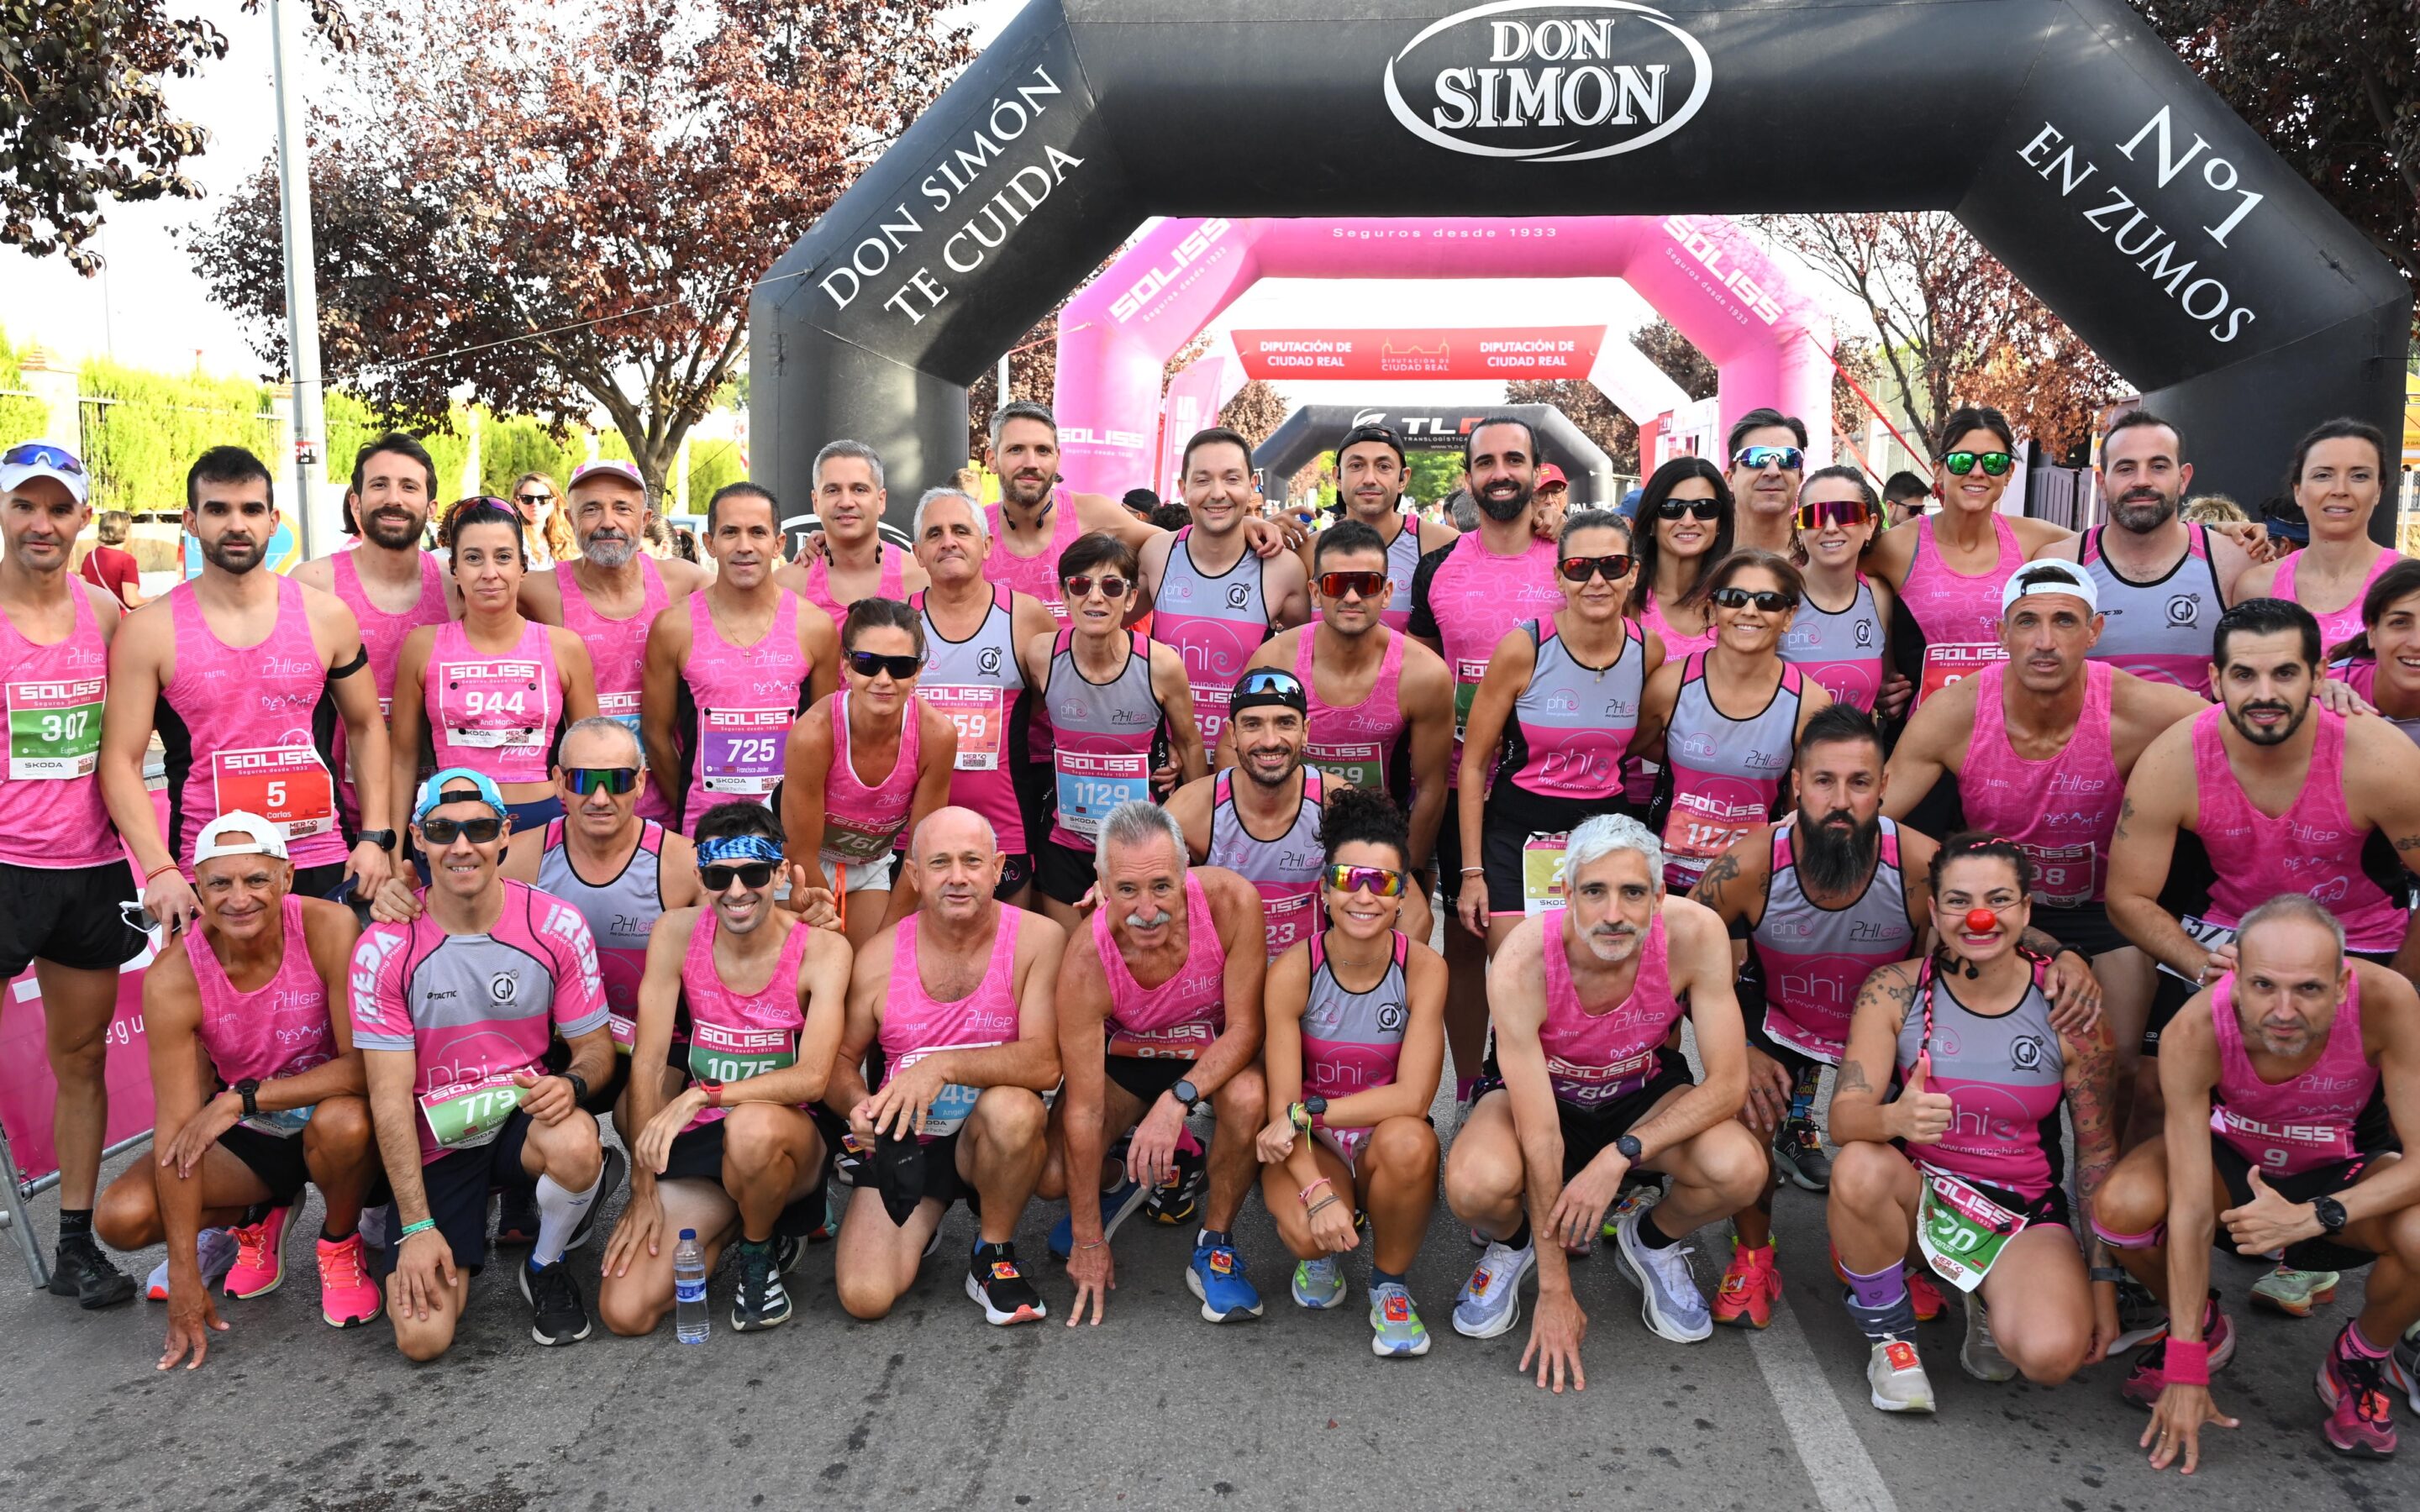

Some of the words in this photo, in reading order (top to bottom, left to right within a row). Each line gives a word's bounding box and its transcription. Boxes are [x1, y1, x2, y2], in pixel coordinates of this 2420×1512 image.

[1490, 18, 1614, 62] DON
[1433, 65, 1670, 129] SIMON
[818, 203, 923, 310] DON
[920, 65, 1062, 213] SIMÓN
[883, 268, 949, 326] TE
[943, 145, 1085, 273] CUIDA
[1333, 227, 1421, 240] Seguros
[1433, 227, 1496, 238] desde
[1509, 226, 1557, 238] 1933
[2017, 122, 2098, 197] EN
[2083, 186, 2255, 343] ZUMOS
[1108, 218, 1232, 323] SOLISS
[1662, 215, 1786, 327] SOLISS
[1665, 247, 1700, 281] Seguros
[1701, 281, 1726, 305] desde
[1728, 305, 1749, 326] 1933
[1260, 339, 1330, 353] DIPUTACIÓN
[1338, 342, 1352, 352] DE
[1480, 339, 1552, 353] DIPUTACIÓN
[1558, 340, 1575, 351] DE
[1267, 356, 1314, 367] CIUDAD
[1316, 356, 1345, 367] REAL
[1487, 356, 1535, 367] CIUDAD
[1538, 355, 1567, 366] REAL
[1058, 427, 1144, 449] SOLISS
[1929, 648, 2011, 661] SOLISS
[450, 664, 534, 680] SOLISS
[19, 680, 102, 701] SOLISS
[915, 688, 994, 701] SOLISS
[466, 690, 525, 716] 944
[597, 695, 641, 709] SOL
[42, 710, 89, 742] 307
[709, 712, 788, 726] SOLISS
[224, 750, 318, 769] SOLISS
[727, 738, 776, 763] 725
[238, 768, 267, 776] Seguros
[1062, 755, 1139, 772] SOLISS
[1539, 748, 1595, 777] phi
[266, 780, 287, 807] 5
[1074, 782, 1130, 807] 1129
[1677, 791, 1765, 817] SOLISS
[266, 811, 292, 820] Carlos
[433, 990, 457, 1000] TACTIC
[1781, 972, 1844, 1004] phi
[698, 1026, 785, 1047] SOLISS
[708, 1058, 776, 1084] 1075
[1315, 1059, 1362, 1088] phi
[1547, 1059, 1643, 1079] SOLISS
[1558, 1080, 1623, 1100] 780
[458, 1089, 517, 1125] 779
[2223, 1110, 2335, 1143] SOLISS
[2263, 1147, 2289, 1168] 9
